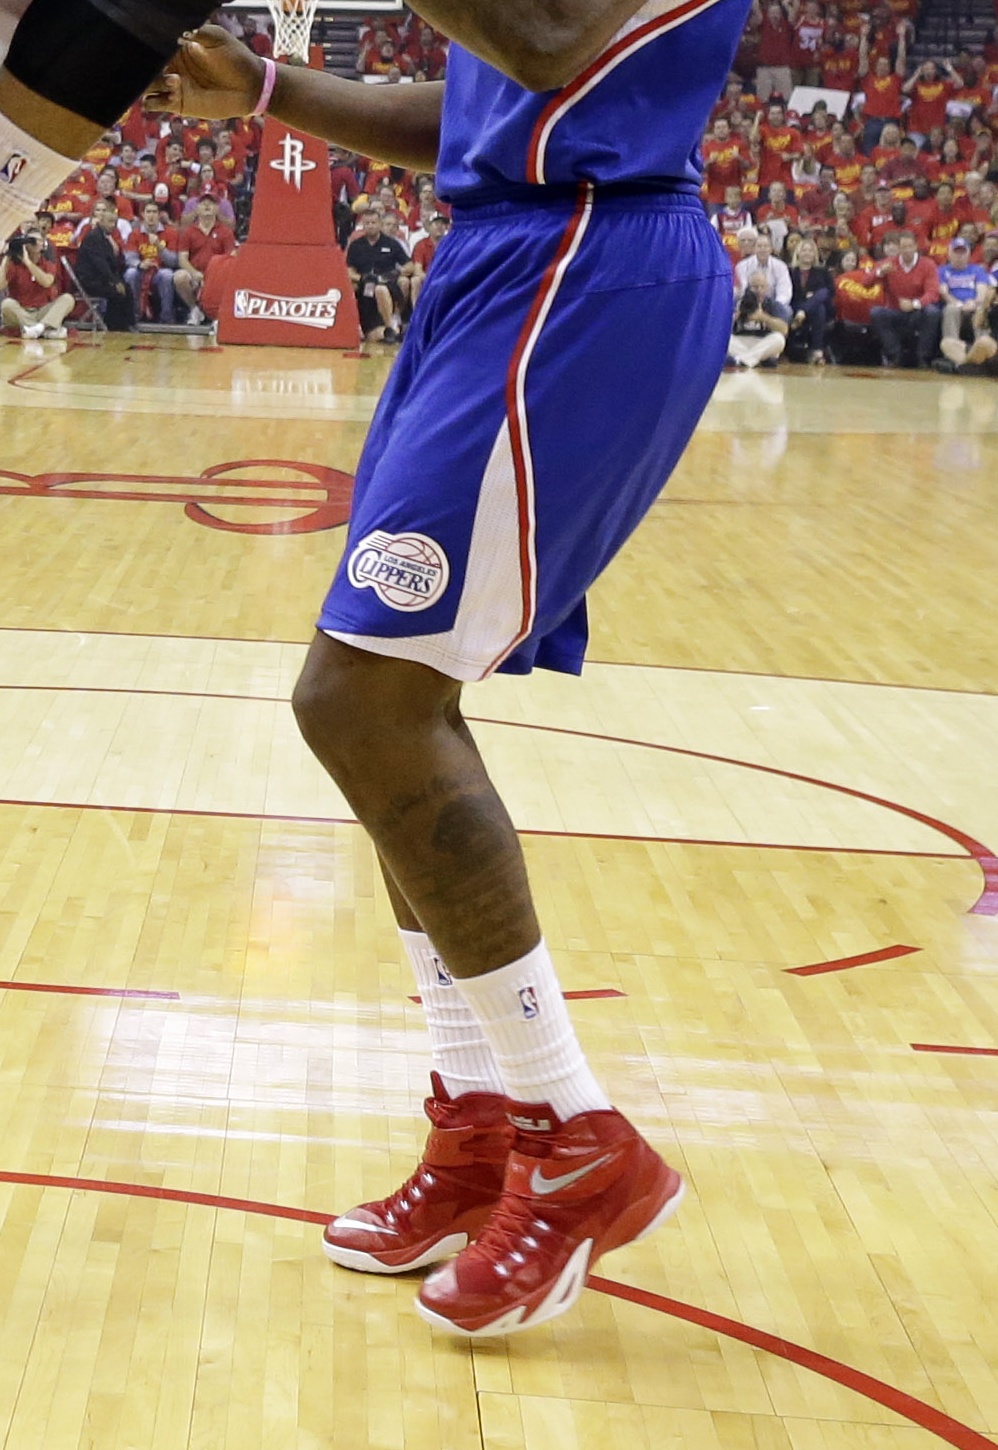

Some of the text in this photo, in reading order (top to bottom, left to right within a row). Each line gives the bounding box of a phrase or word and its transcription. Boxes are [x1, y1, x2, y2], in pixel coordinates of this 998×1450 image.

[247, 297, 337, 318] PLAYOFFS
[352, 548, 435, 594] CLIPPERS
[383, 555, 438, 577] LOS ANGELES
